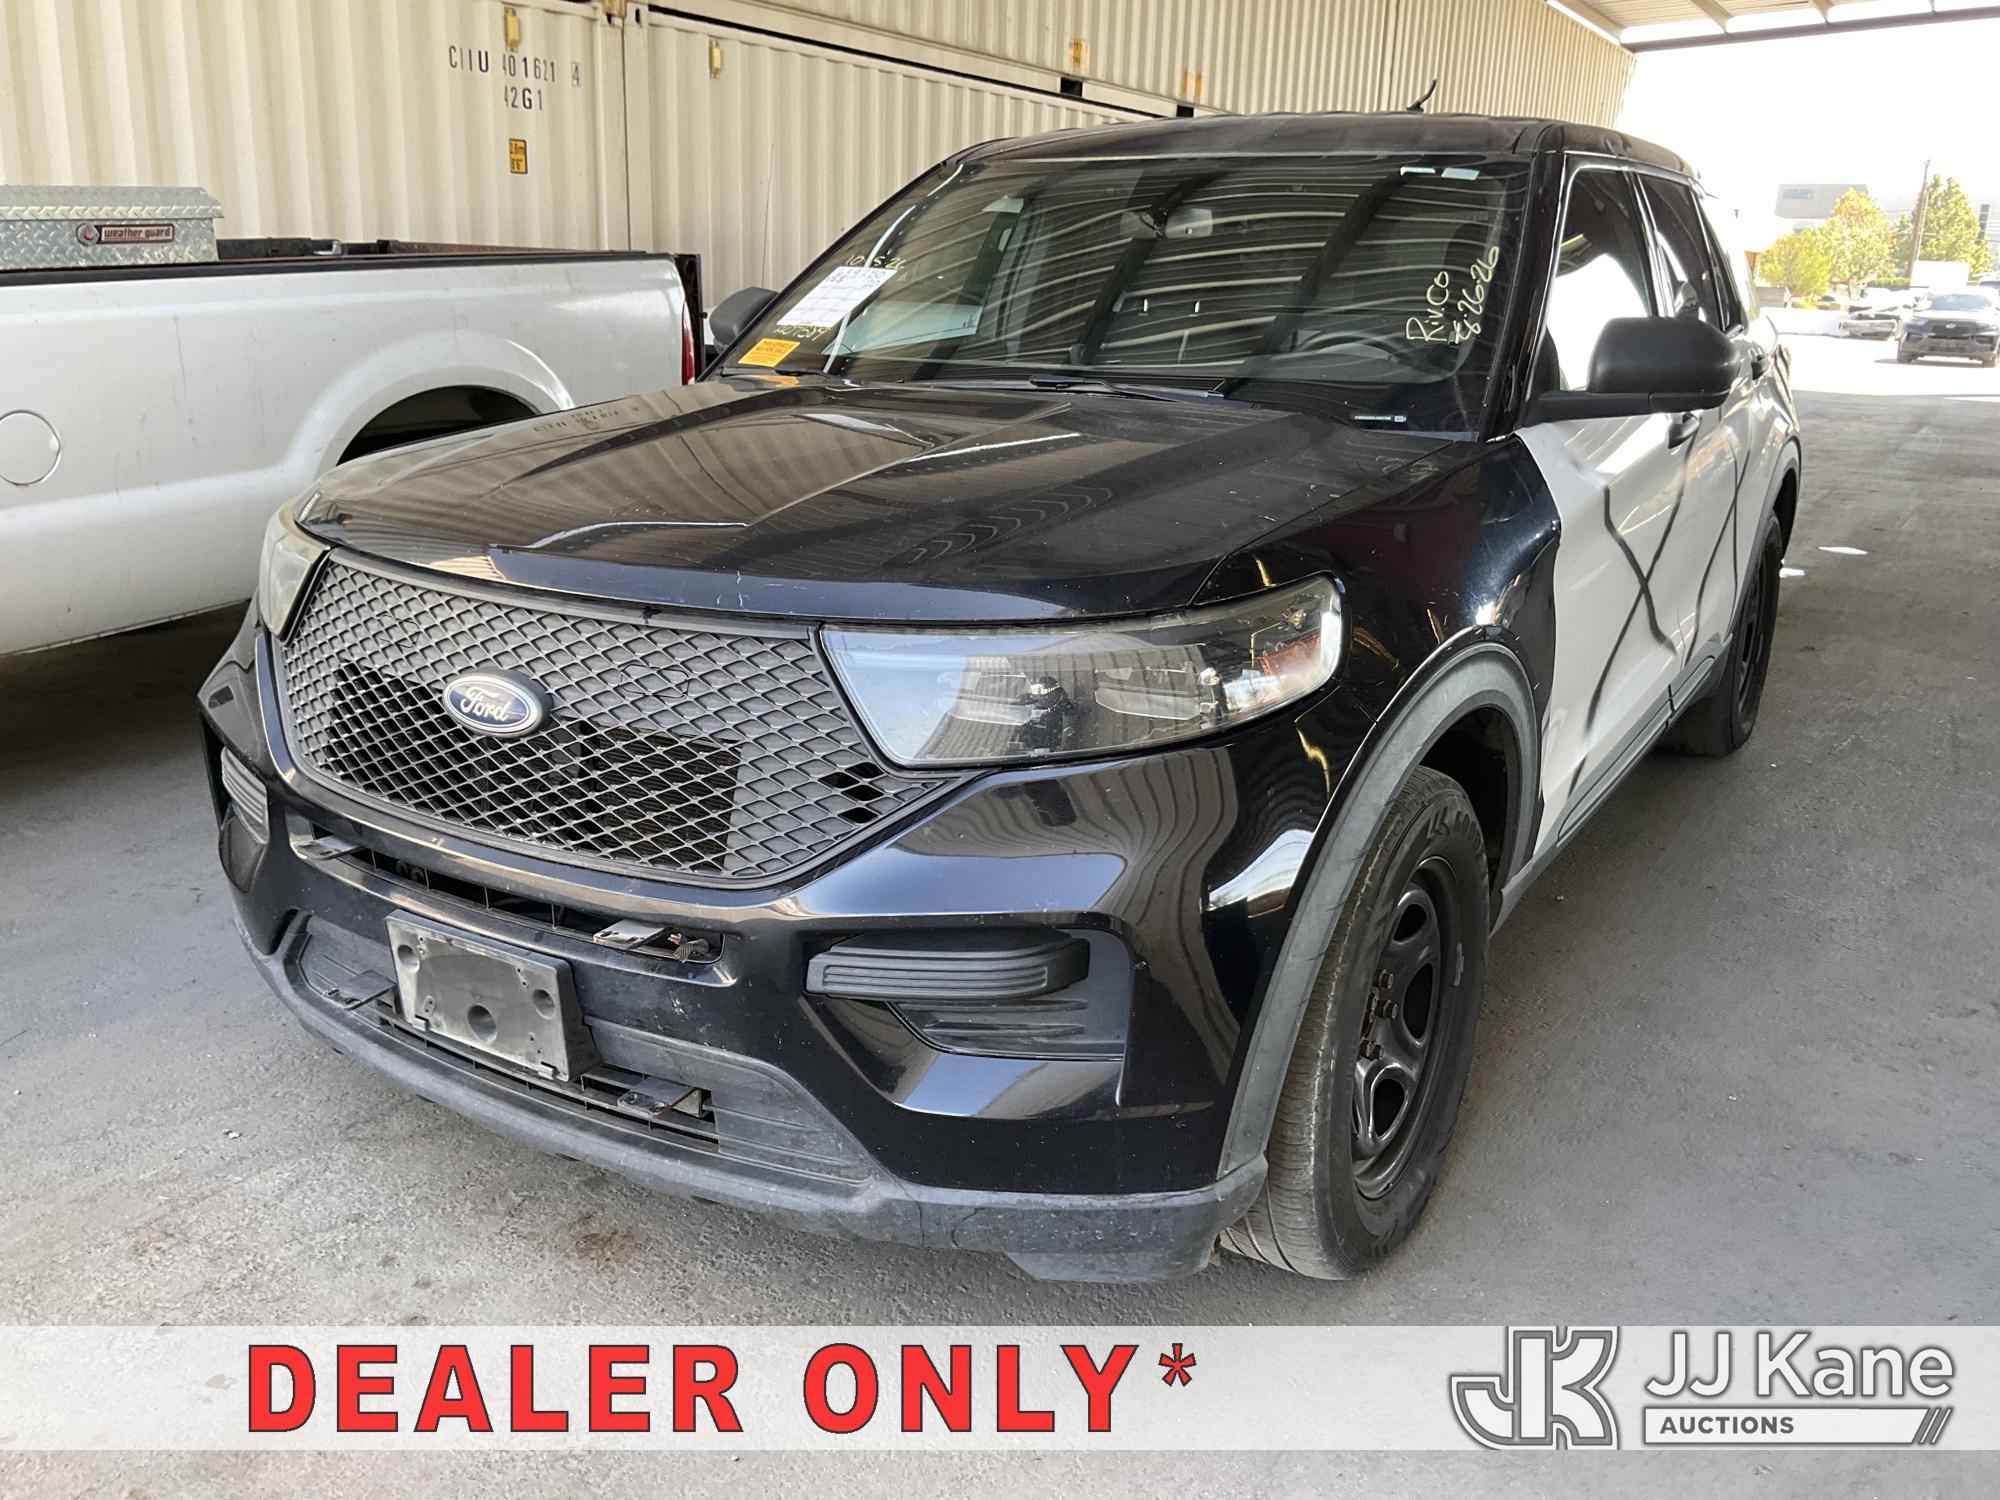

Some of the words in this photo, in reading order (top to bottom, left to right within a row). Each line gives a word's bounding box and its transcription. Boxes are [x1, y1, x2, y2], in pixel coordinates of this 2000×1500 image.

[104, 227, 142, 238] weather
[144, 227, 170, 239] guard
[461, 687, 511, 721] Ford
